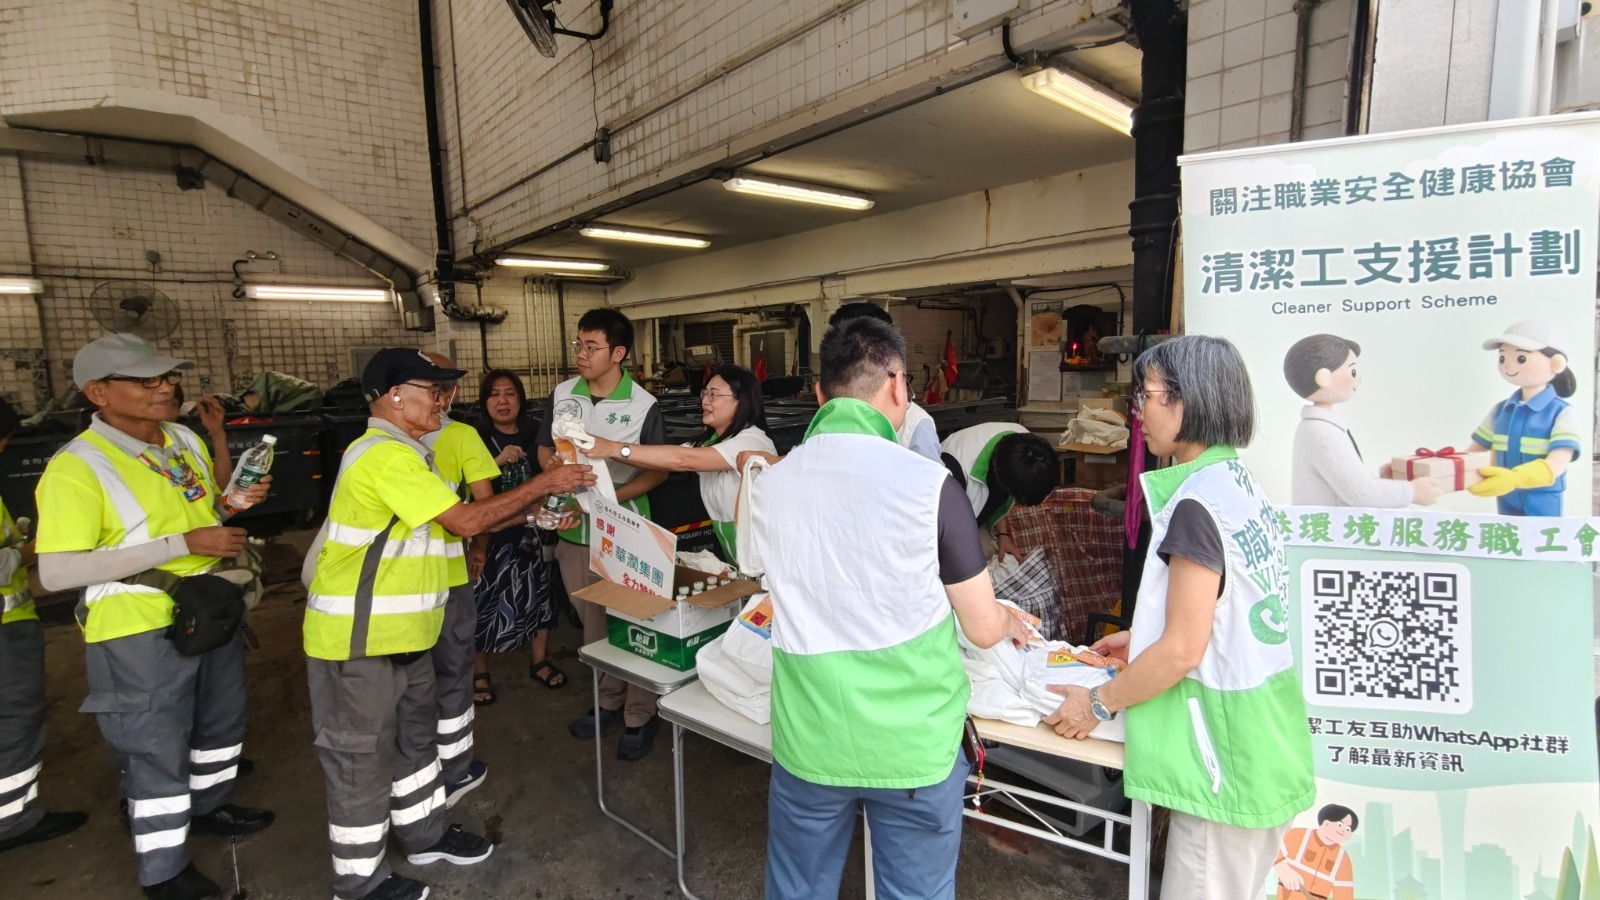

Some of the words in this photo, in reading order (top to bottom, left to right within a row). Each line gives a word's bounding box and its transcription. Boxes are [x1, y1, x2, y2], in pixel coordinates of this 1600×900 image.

[1209, 156, 1576, 216] 關注職業安全健康協會
[1201, 229, 1581, 294] 清潔工支援計劃
[1271, 301, 1332, 315] Cleaner
[1342, 298, 1411, 313] Support
[1421, 294, 1498, 309] Scheme
[596, 517, 616, 538] 感謝
[615, 545, 664, 588] 華潤集團
[1327, 745, 1465, 773] 了解最新資訊
